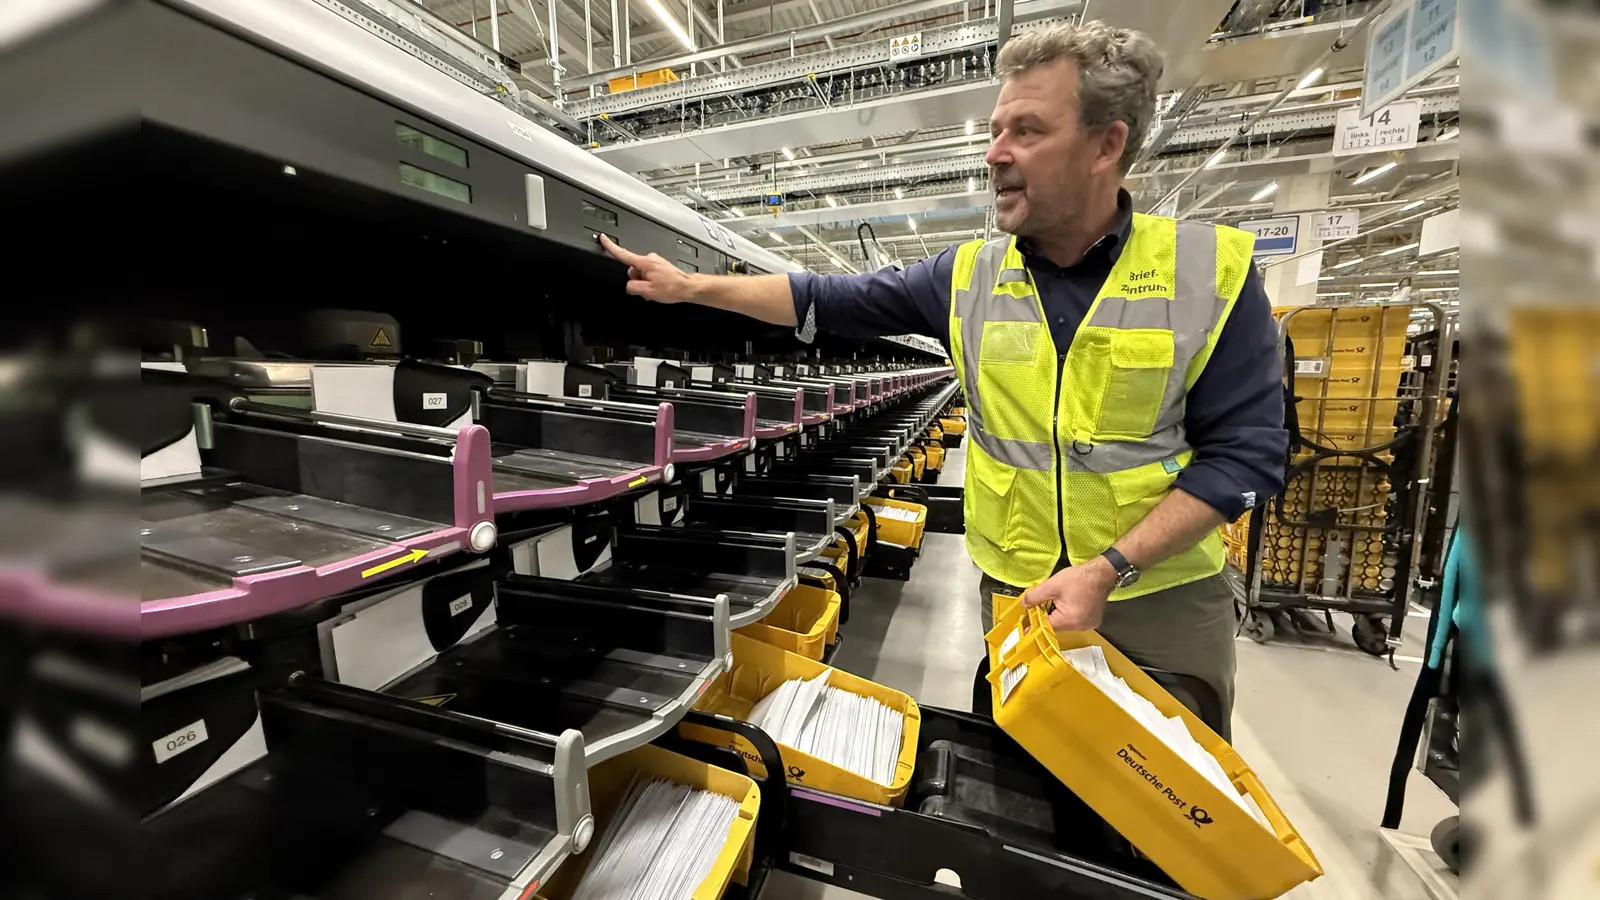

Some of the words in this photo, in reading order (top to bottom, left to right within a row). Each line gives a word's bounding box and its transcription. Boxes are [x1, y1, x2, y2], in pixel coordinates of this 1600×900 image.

[1424, 46, 1436, 63] 12
[1366, 109, 1391, 128] 14
[1350, 131, 1370, 140] links
[1379, 127, 1405, 136] rechts
[1364, 139, 1371, 147] 2
[1380, 137, 1387, 145] 3
[1327, 215, 1343, 225] 17
[1256, 226, 1289, 238] 17-20
[1129, 269, 1159, 281] Brief-
[428, 397, 443, 406] 027
[454, 600, 469, 611] 028
[166, 731, 197, 752] 026
[1116, 748, 1164, 790] Deutsche
[1162, 787, 1187, 810] Post
